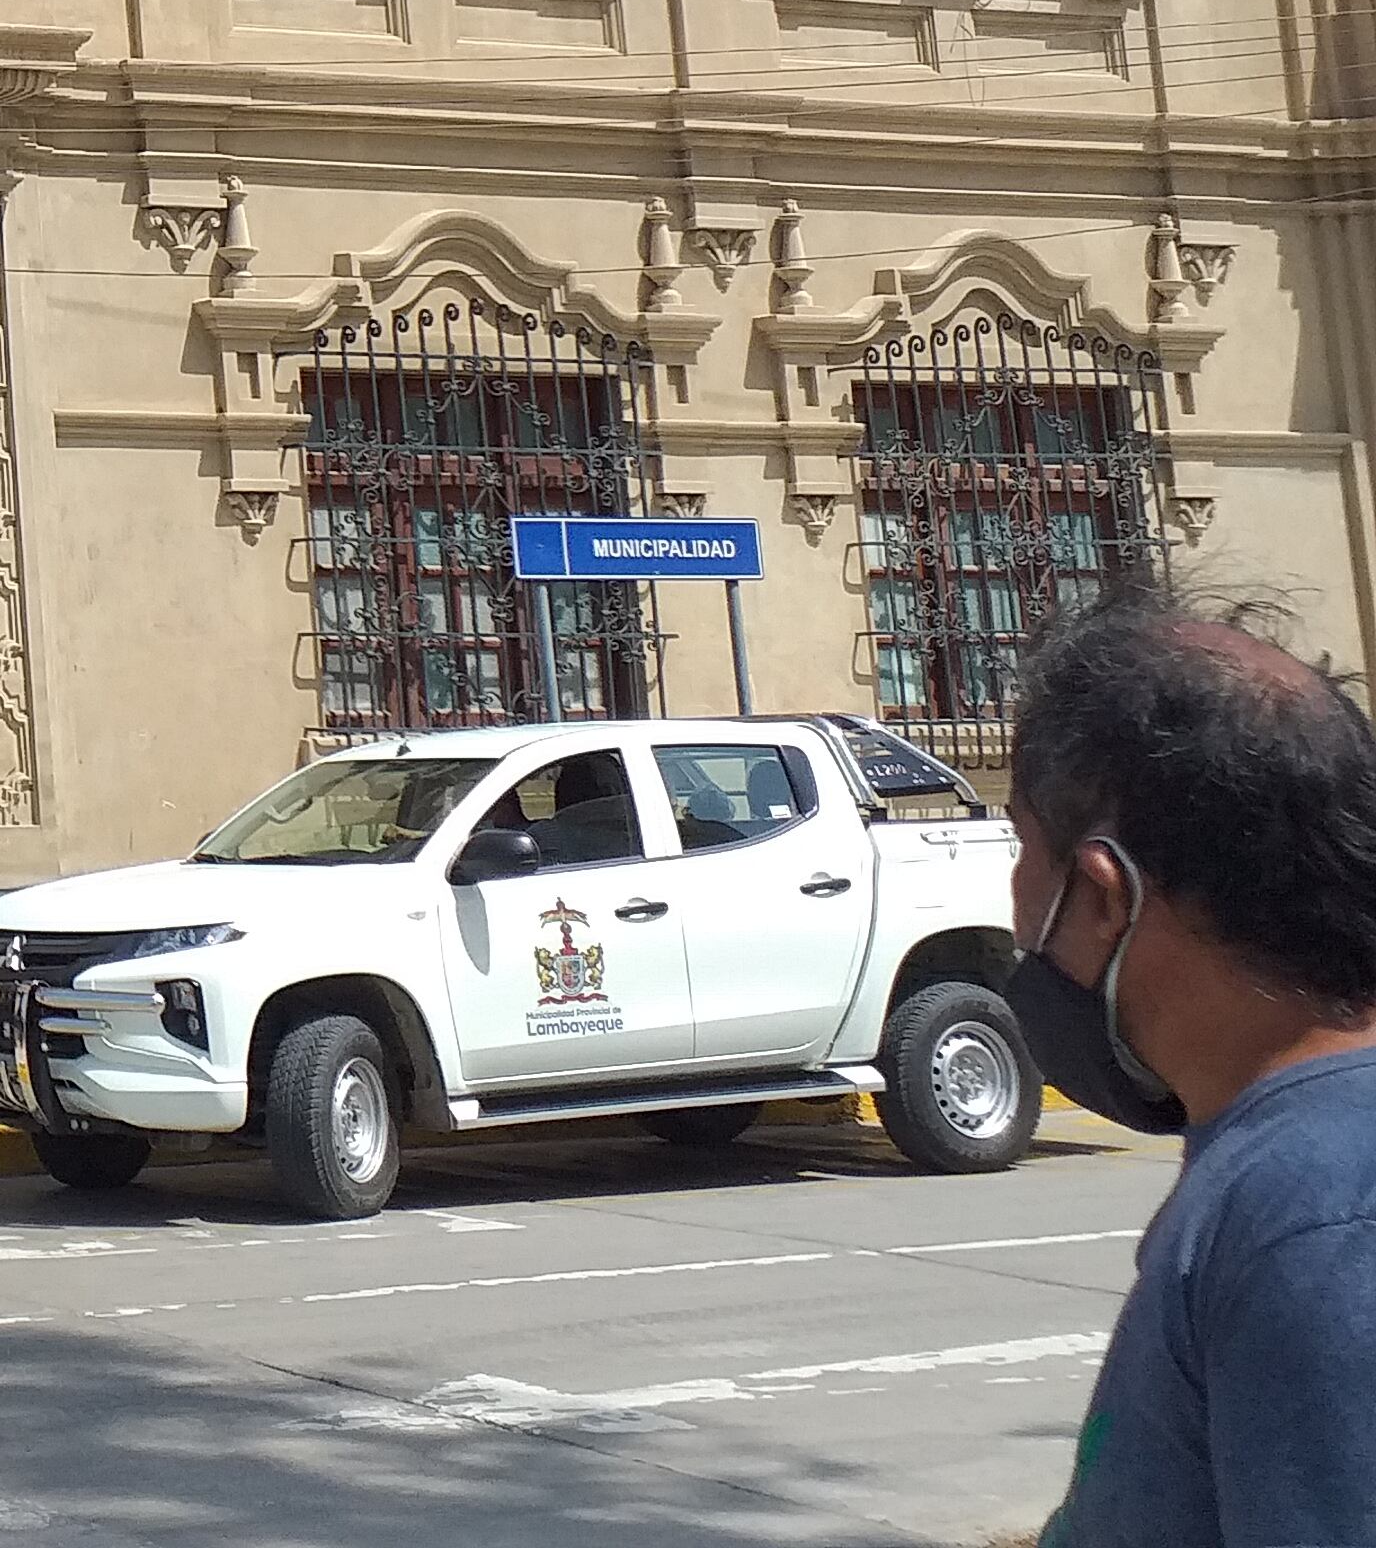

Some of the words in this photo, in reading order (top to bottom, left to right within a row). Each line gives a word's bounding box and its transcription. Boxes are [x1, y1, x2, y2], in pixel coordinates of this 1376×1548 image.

[592, 538, 736, 558] MUNICIPALIDAD
[526, 1010, 575, 1020] Municipalidad
[576, 1007, 611, 1017] Provincial
[612, 1006, 622, 1014] de
[526, 1018, 624, 1036] Lambayeque
